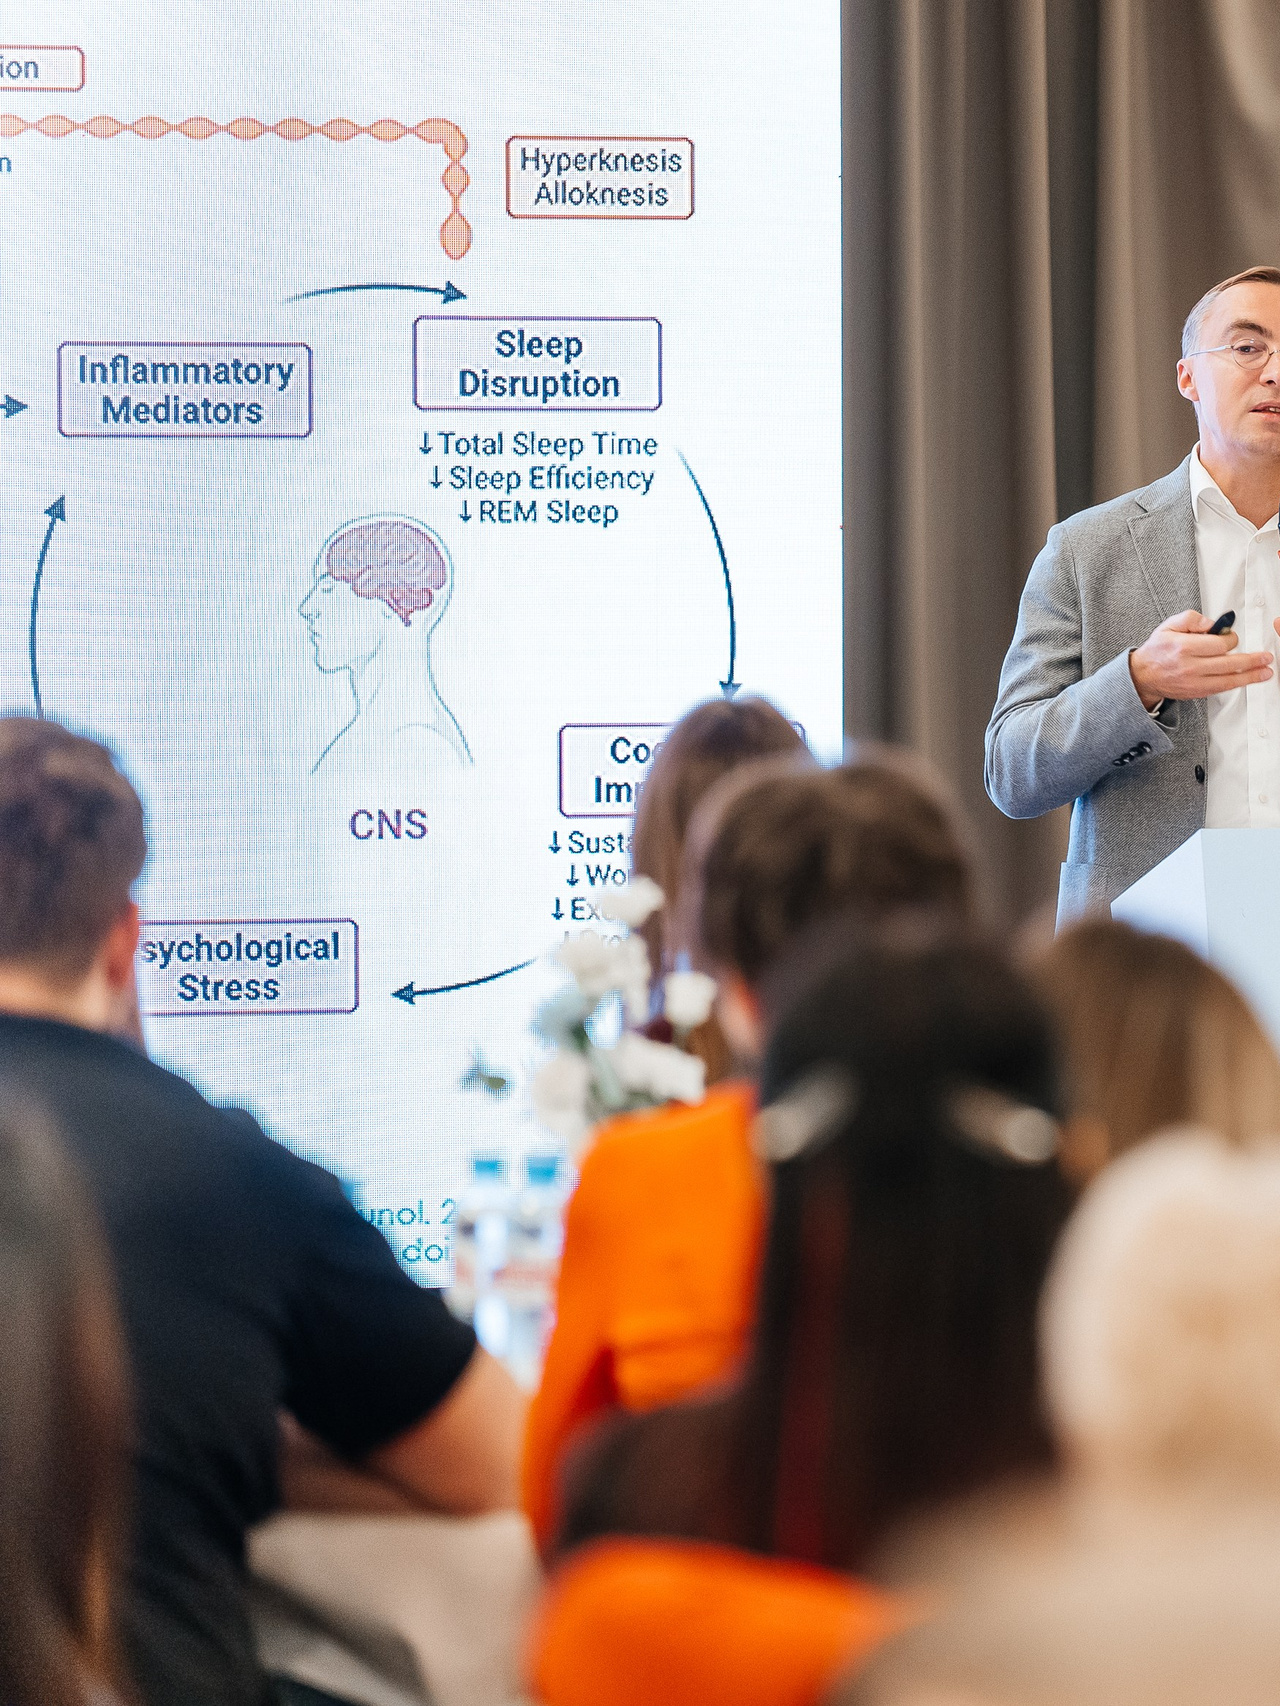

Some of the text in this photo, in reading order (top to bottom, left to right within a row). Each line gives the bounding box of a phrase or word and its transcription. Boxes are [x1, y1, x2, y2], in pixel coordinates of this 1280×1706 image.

[520, 147, 683, 177] Hyperknesis
[534, 181, 669, 207] Alloknesis
[495, 331, 583, 364] Sleep
[79, 354, 295, 390] Inflammatory
[459, 371, 620, 403] Disruption
[102, 396, 263, 425] Mediators
[438, 432, 658, 461] Total Sleep Time
[449, 465, 655, 496] Sleep Efficiency
[479, 500, 620, 529] REM Sleep
[349, 809, 428, 841] CNS
[568, 830, 632, 854] Sust
[140, 931, 340, 970] sychological
[178, 973, 280, 1002] Stress
